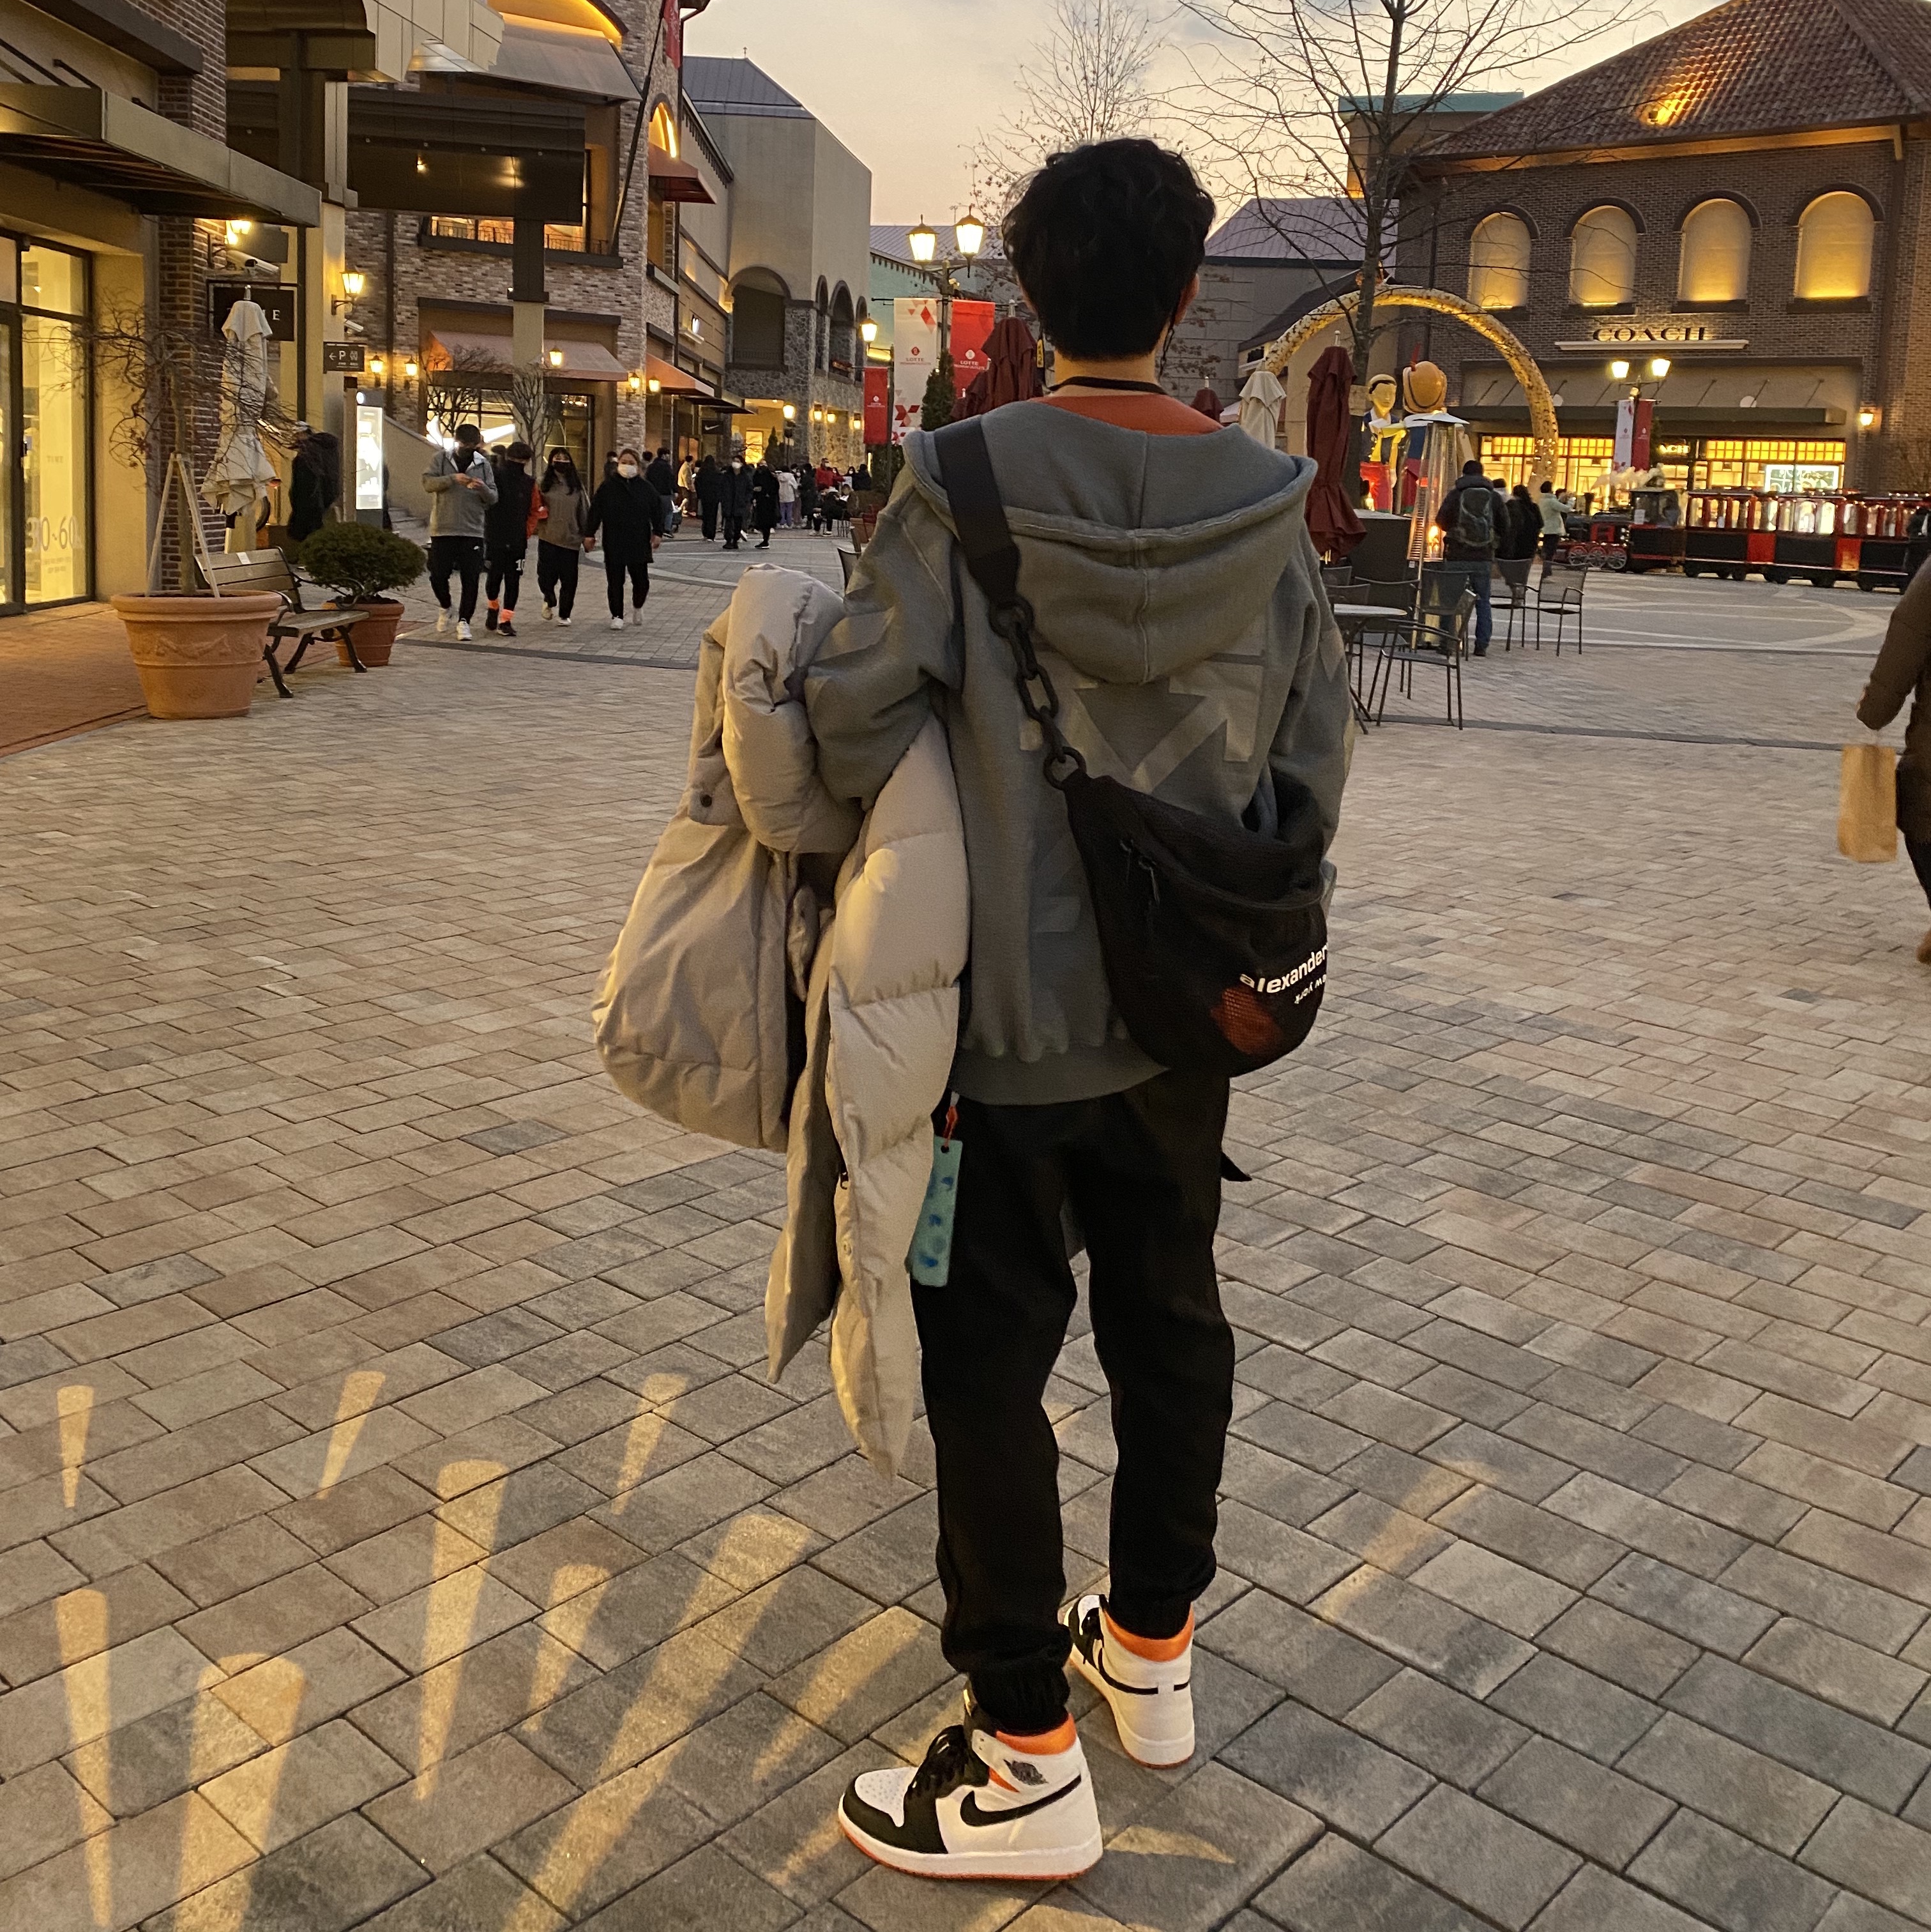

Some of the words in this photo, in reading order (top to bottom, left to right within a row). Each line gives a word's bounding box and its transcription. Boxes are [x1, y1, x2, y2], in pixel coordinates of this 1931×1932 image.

[1593, 326, 1707, 342] COACH
[339, 350, 346, 360] P
[1659, 445, 1690, 453] ACH
[1239, 945, 1328, 994] alexander
